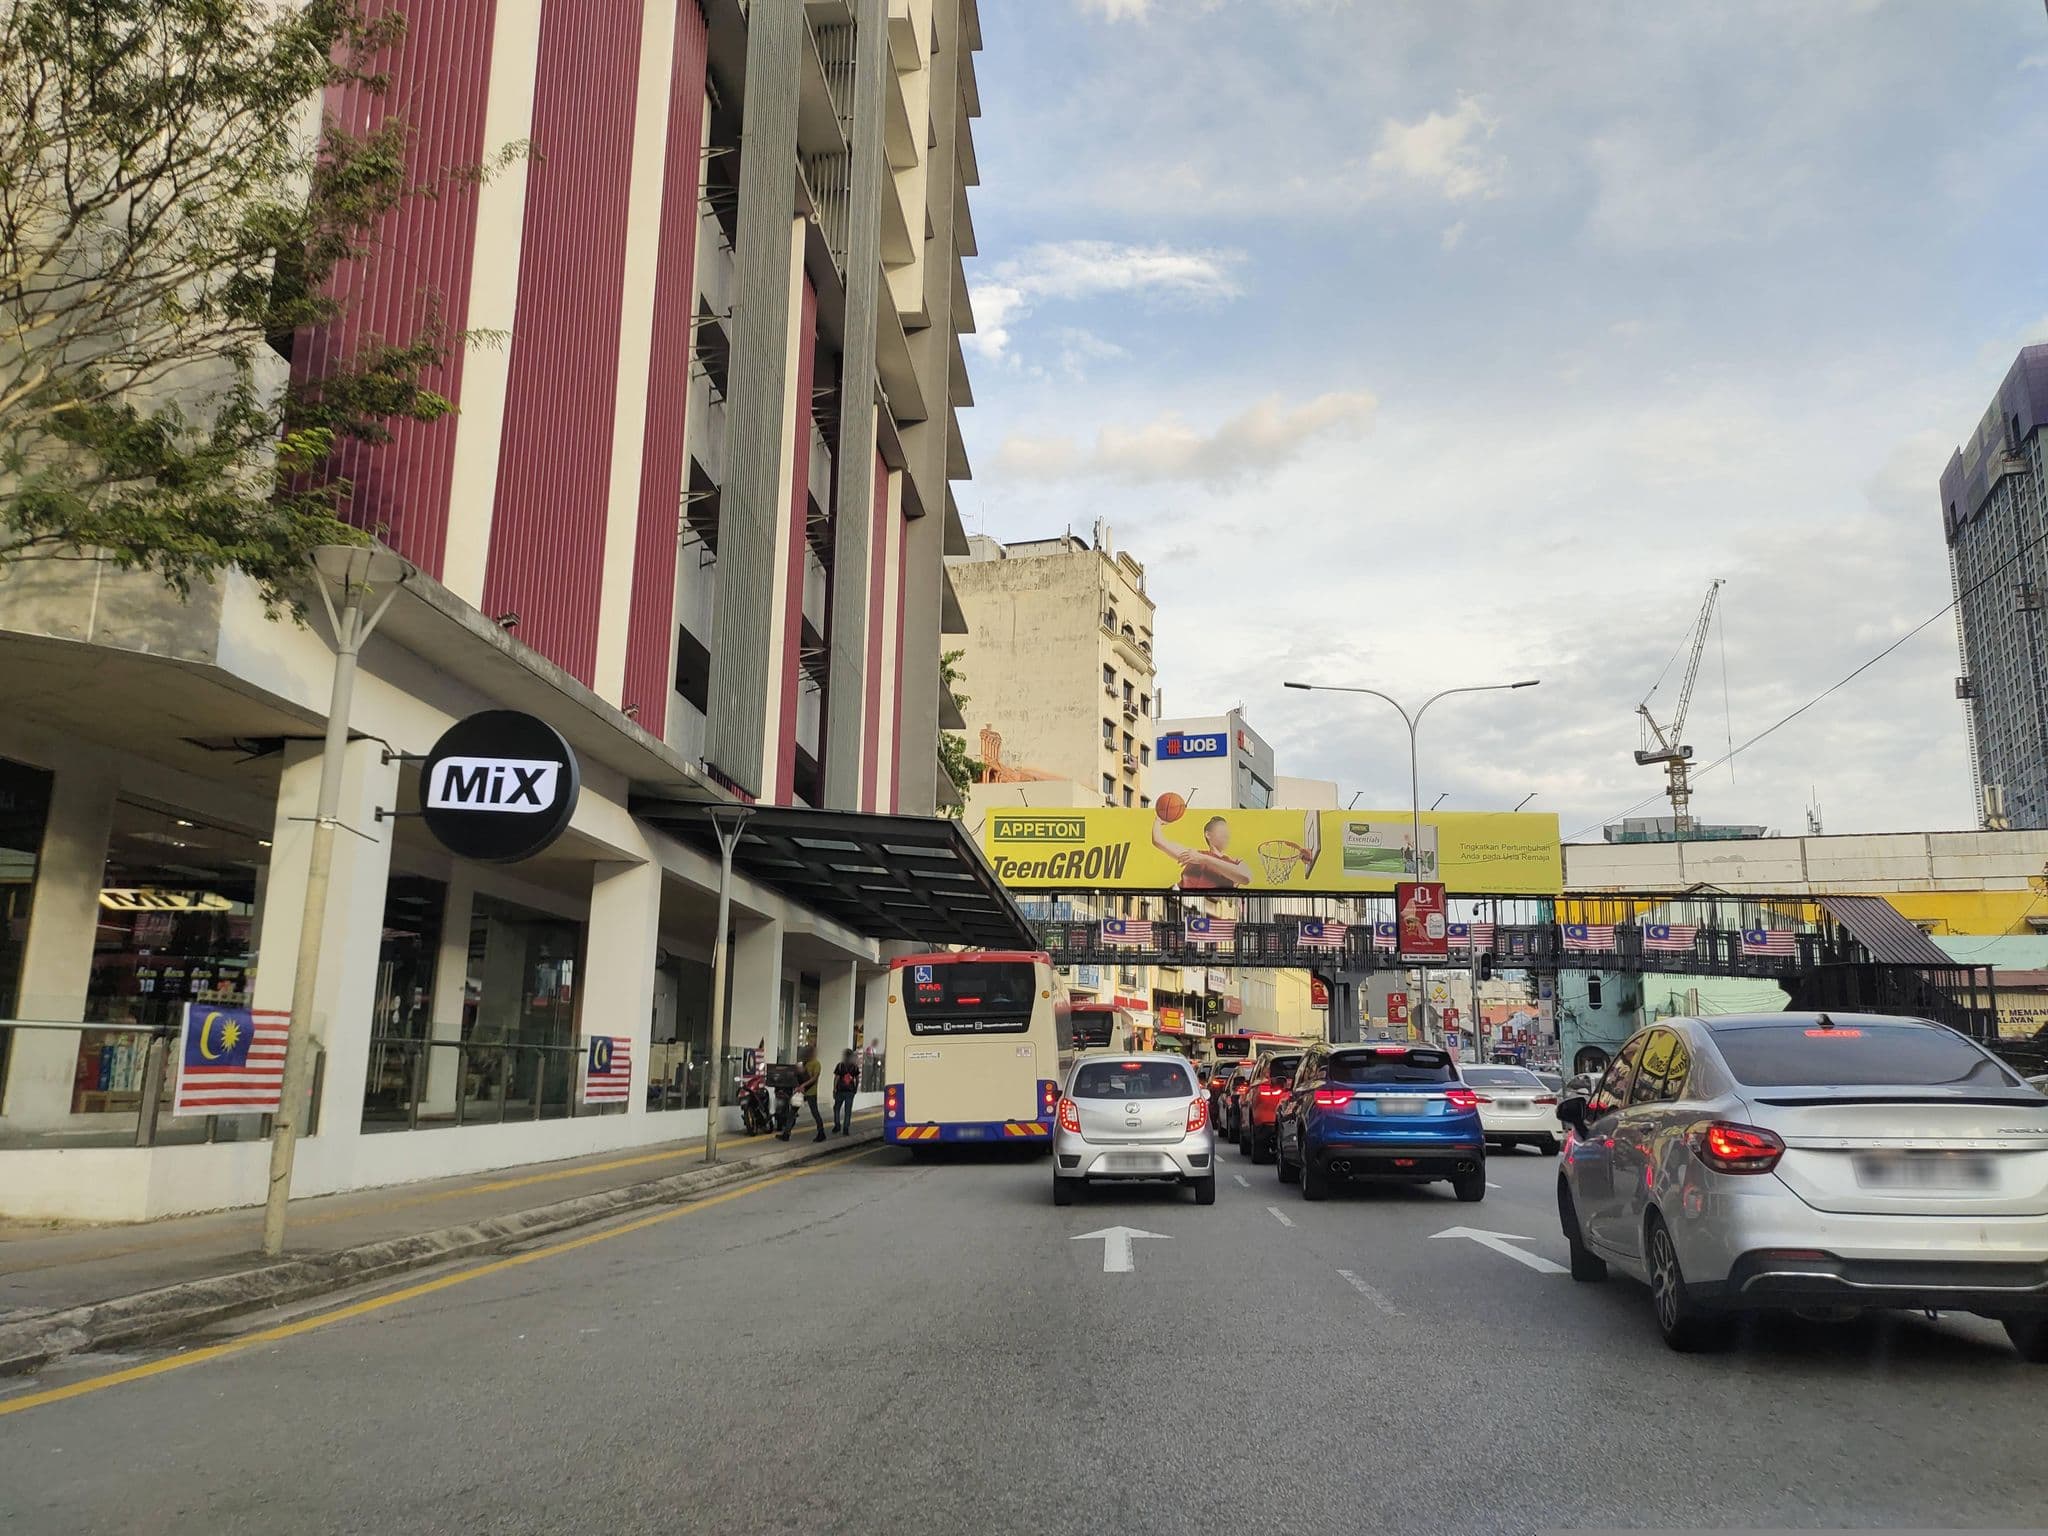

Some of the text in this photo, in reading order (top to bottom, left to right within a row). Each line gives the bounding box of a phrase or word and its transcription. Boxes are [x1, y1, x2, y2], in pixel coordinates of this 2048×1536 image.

[1183, 738, 1217, 752] UOB
[441, 765, 547, 805] MiX
[1000, 823, 1080, 836] APPETON
[1460, 843, 1550, 852] Tingkatkan Pertumbuhan
[994, 842, 1131, 879] TeenGROW
[1521, 854, 1550, 862] Remaja
[2009, 1009, 2048, 1017] MEMAN
